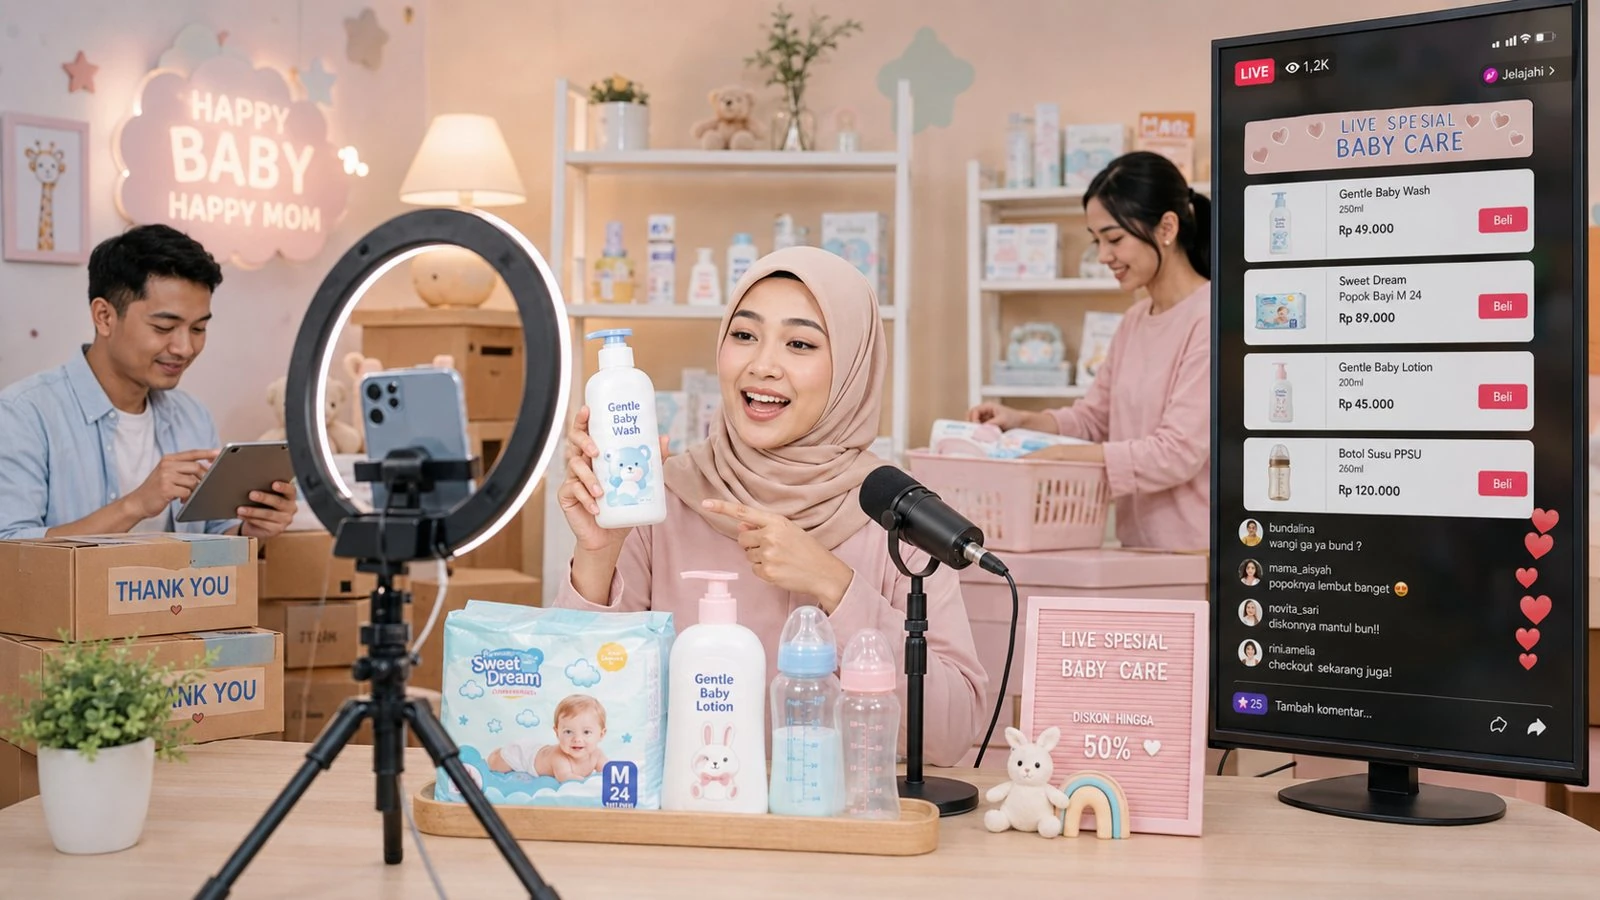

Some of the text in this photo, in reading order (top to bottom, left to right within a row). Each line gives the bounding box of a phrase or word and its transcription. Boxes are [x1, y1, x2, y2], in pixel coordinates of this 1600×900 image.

[1240, 59, 1330, 79] LIVE 1,2K
[1502, 66, 1545, 81] Jelajahi
[191, 89, 290, 135] HAPPY
[1341, 112, 1456, 134] LIVE SPESIAL
[1336, 131, 1463, 159] BABY CARE
[169, 125, 315, 195] BABY
[1339, 185, 1431, 200] Gentle Baby Wash
[169, 191, 321, 233] HAPPY MOM
[1339, 204, 1364, 214] 250ml
[1493, 214, 1513, 226] Beli
[1339, 223, 1394, 237] Rp 49.000
[1339, 275, 1407, 286] Sweet Dream
[1339, 290, 1422, 303] Popok Bayi M 24
[1493, 301, 1513, 312] Beli
[1339, 312, 1395, 325] Rp 89.000
[1338, 362, 1433, 374] Gentle Baby Lotion
[1338, 378, 1364, 387] 200ml
[1493, 392, 1512, 402] Beli
[607, 401, 640, 412] Gentle
[1338, 398, 1394, 411] Rp 45.000
[613, 413, 638, 426] Baby
[612, 425, 641, 437] Wash
[1339, 448, 1422, 460] Botol Susu PPSU
[1339, 464, 1364, 473] 260ml
[1493, 478, 1512, 490] Beli
[1338, 485, 1400, 497] Rp 120.000
[1269, 523, 1315, 534] bundalina
[1269, 539, 1298, 551] wangi
[1300, 542, 1313, 552] ga
[1315, 542, 1326, 552] ya
[1328, 540, 1354, 551] bund
[1269, 564, 1332, 577] mama_aisyah
[115, 575, 229, 602] THANK YOU
[1269, 579, 1390, 596] popoknya lembut banget
[1269, 603, 1319, 617] novita_sari
[1268, 618, 1380, 635] diskonnya mantul bun!!
[1061, 631, 1168, 650] LIVE SPESIAL
[1268, 644, 1315, 656] rini.amelia
[473, 655, 521, 672] Sweet
[1061, 659, 1168, 681] BABY CARE
[1268, 659, 1392, 680] checkout sekarang juga!
[487, 670, 540, 687] Dream
[695, 673, 734, 685] Gentle
[164, 679, 256, 708] ANK YOU
[700, 687, 730, 700] Baby
[696, 701, 734, 712] Lotion
[1250, 698, 1263, 710] 25
[1275, 700, 1372, 719] Tambah komentar...
[1073, 711, 1154, 726] DISKON HINGGA
[1084, 734, 1131, 760] 50%
[611, 765, 630, 785] M
[610, 786, 630, 801] 24
